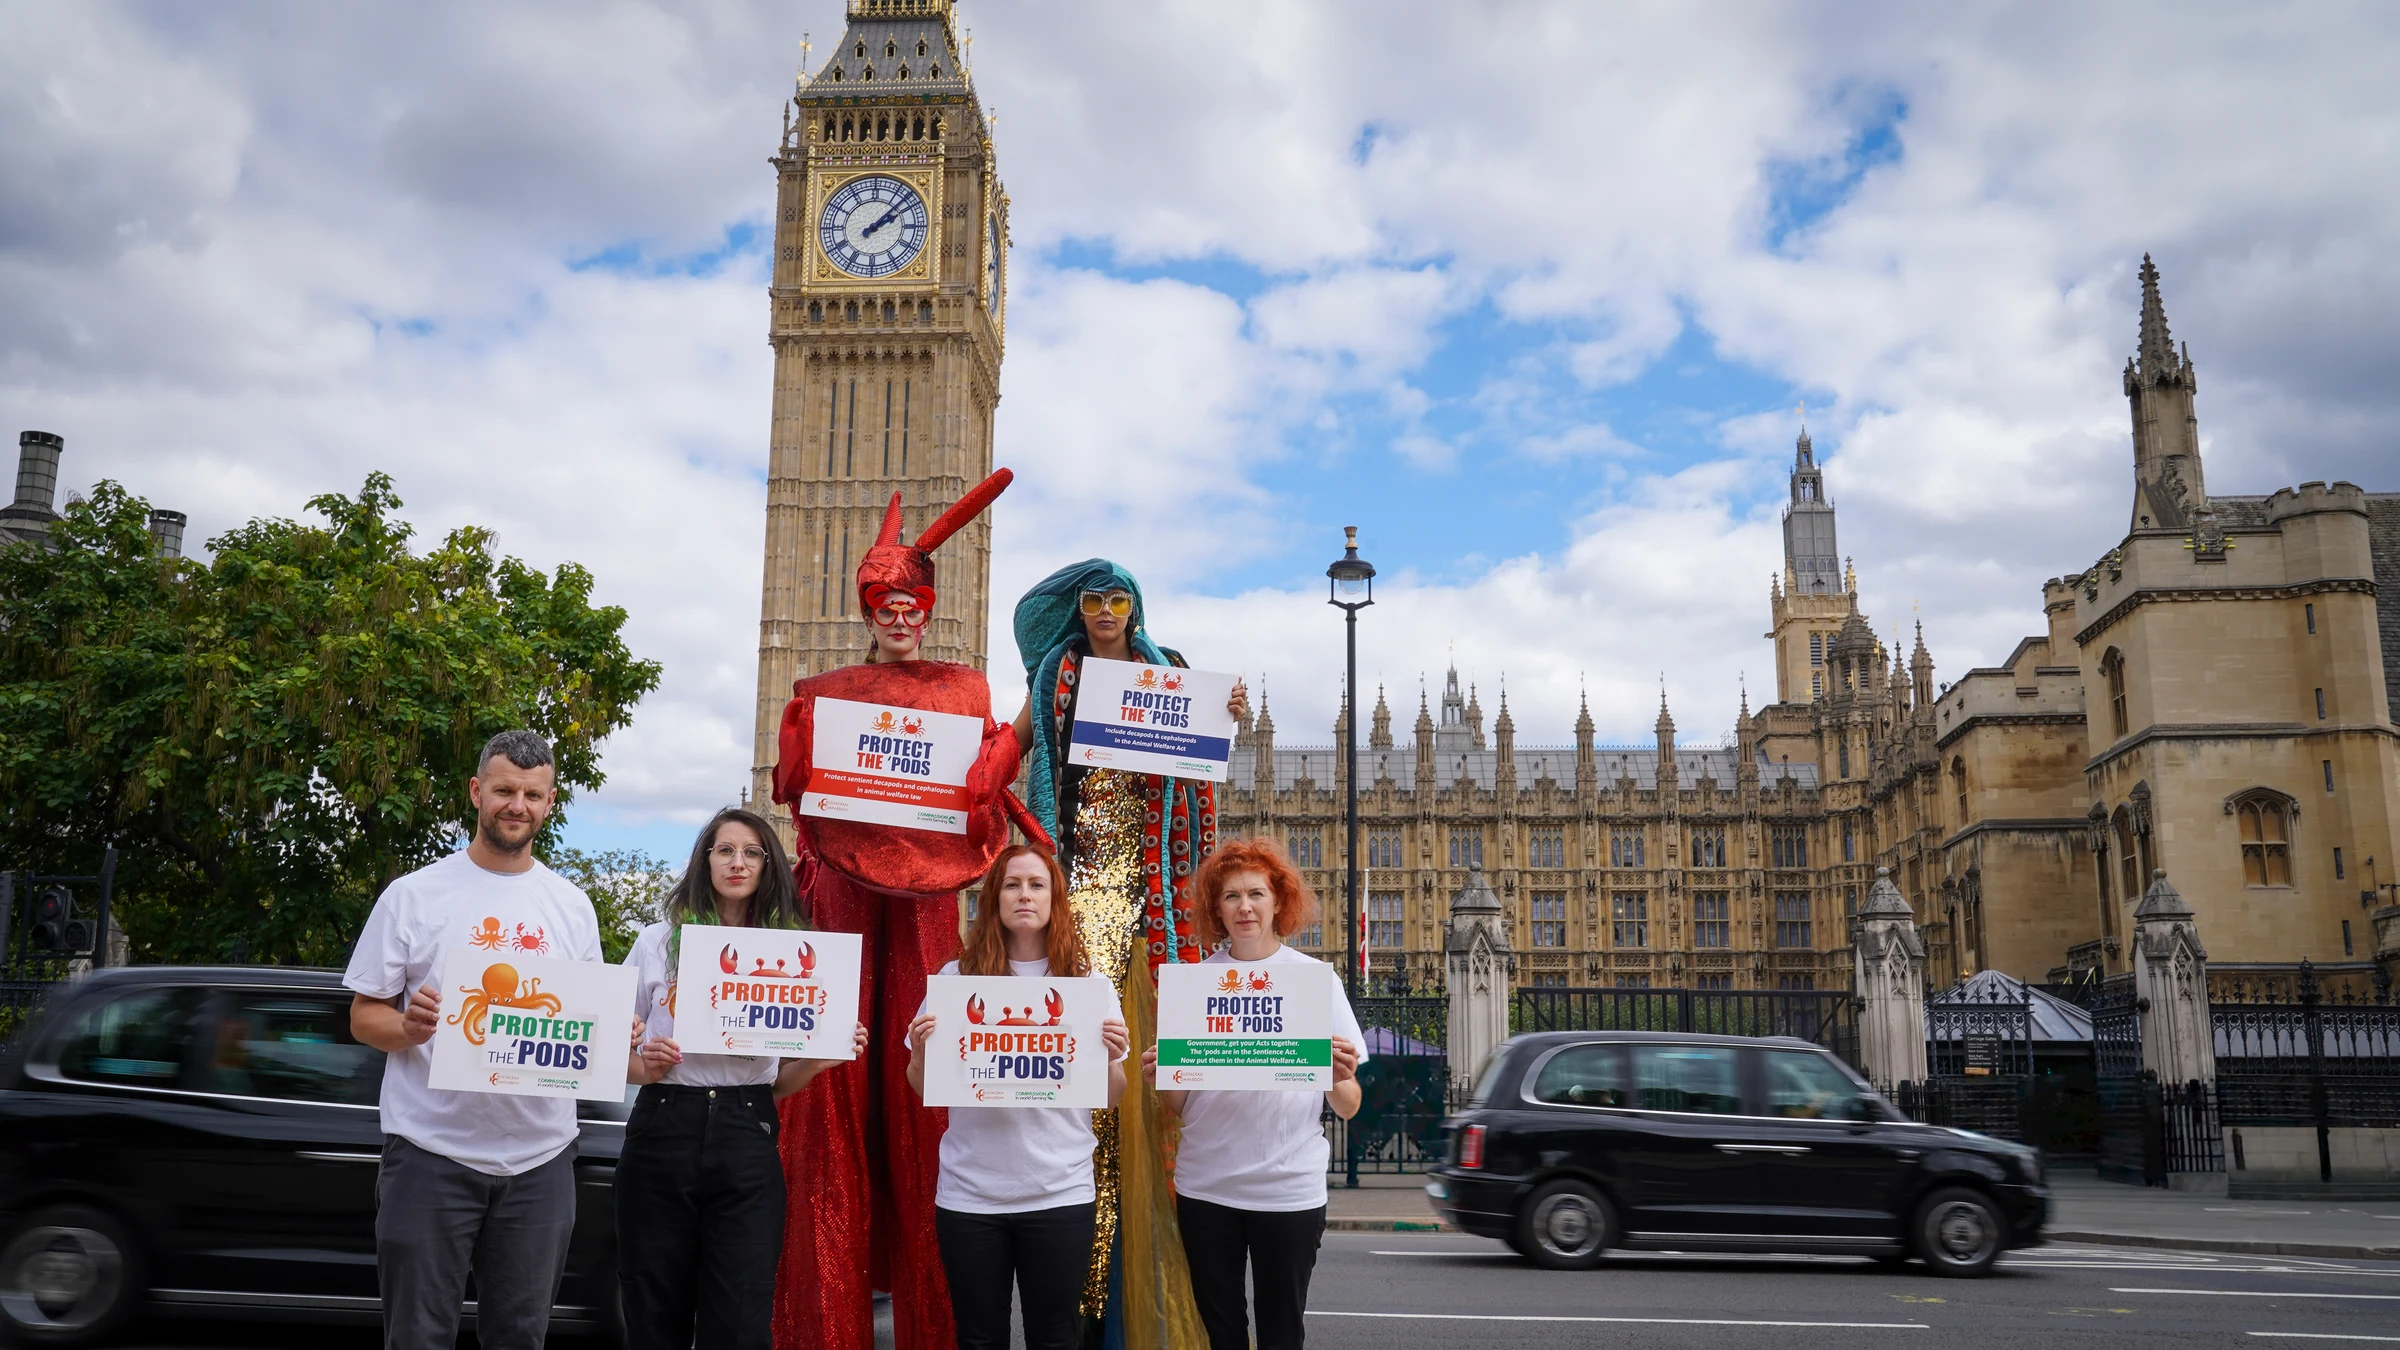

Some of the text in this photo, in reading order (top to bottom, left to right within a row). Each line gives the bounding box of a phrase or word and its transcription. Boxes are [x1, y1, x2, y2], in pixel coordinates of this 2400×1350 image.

[1122, 690, 1192, 713] PROTECT
[1121, 707, 1189, 728] THE 'PODS
[858, 734, 933, 759] PROTECT
[1105, 728, 1126, 736] Include
[1126, 730, 1154, 738] decapods
[1160, 735, 1196, 744] cephalopods
[1154, 742, 1176, 750] Welfare
[857, 752, 931, 776] THE 'PODS
[824, 772, 846, 781] Protect
[848, 776, 872, 784] sentient
[874, 778, 902, 788] decapods
[916, 785, 955, 795] cephalopods
[864, 788, 886, 796] animal
[886, 791, 909, 799] welfare
[722, 982, 818, 1004] PROTECT
[1207, 996, 1283, 1015] PROTECT
[490, 1013, 594, 1042] PROTECT
[720, 1004, 814, 1030] THE 'PODS
[1206, 1016, 1283, 1033] THE 'PODS
[970, 1032, 1067, 1053] PROTECT
[488, 1039, 588, 1070] THE 'PODS
[970, 1054, 1064, 1080] THE 'PODS
